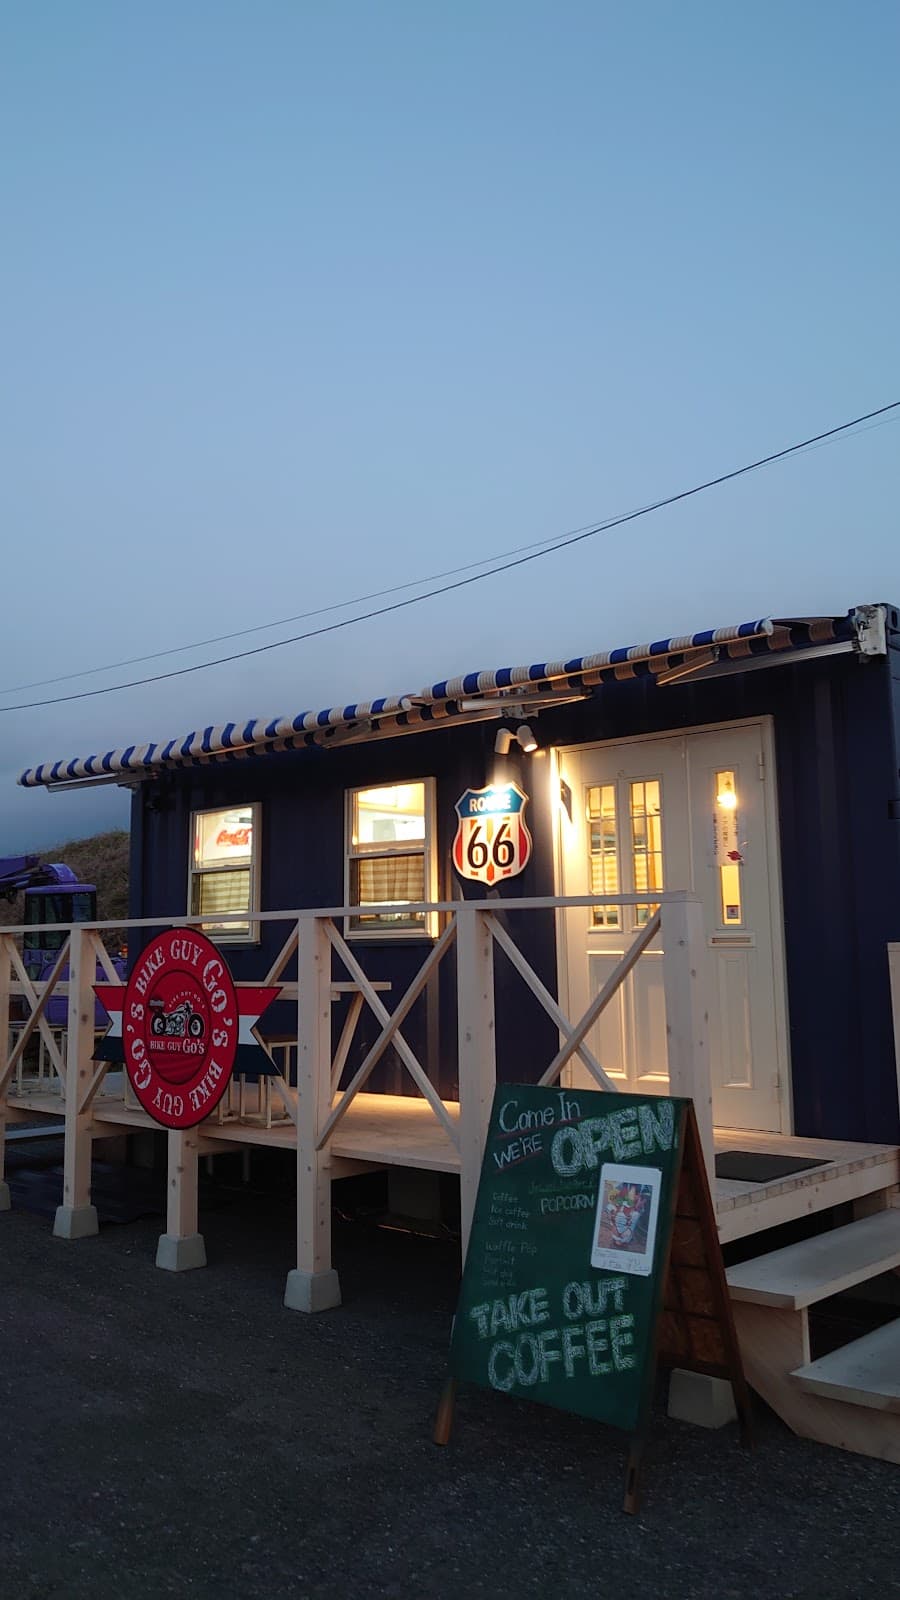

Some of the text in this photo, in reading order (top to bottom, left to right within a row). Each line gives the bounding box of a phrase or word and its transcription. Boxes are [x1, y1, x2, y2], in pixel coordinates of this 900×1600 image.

[469, 793, 511, 812] ROE
[467, 823, 515, 869] 66
[135, 946, 166, 996] BIKE
[170, 939, 203, 967] GUY
[150, 1040, 166, 1050] BIKE
[168, 1041, 182, 1052] GUY
[152, 1086, 184, 1117] GUY
[189, 1057, 223, 1113] BIKE
[498, 1091, 581, 1133] Come In
[493, 1133, 544, 1169] WE'RE
[540, 1192, 595, 1214] POPCORN
[470, 1276, 628, 1338] TAKE OUT
[487, 1313, 636, 1392] COFFEE
